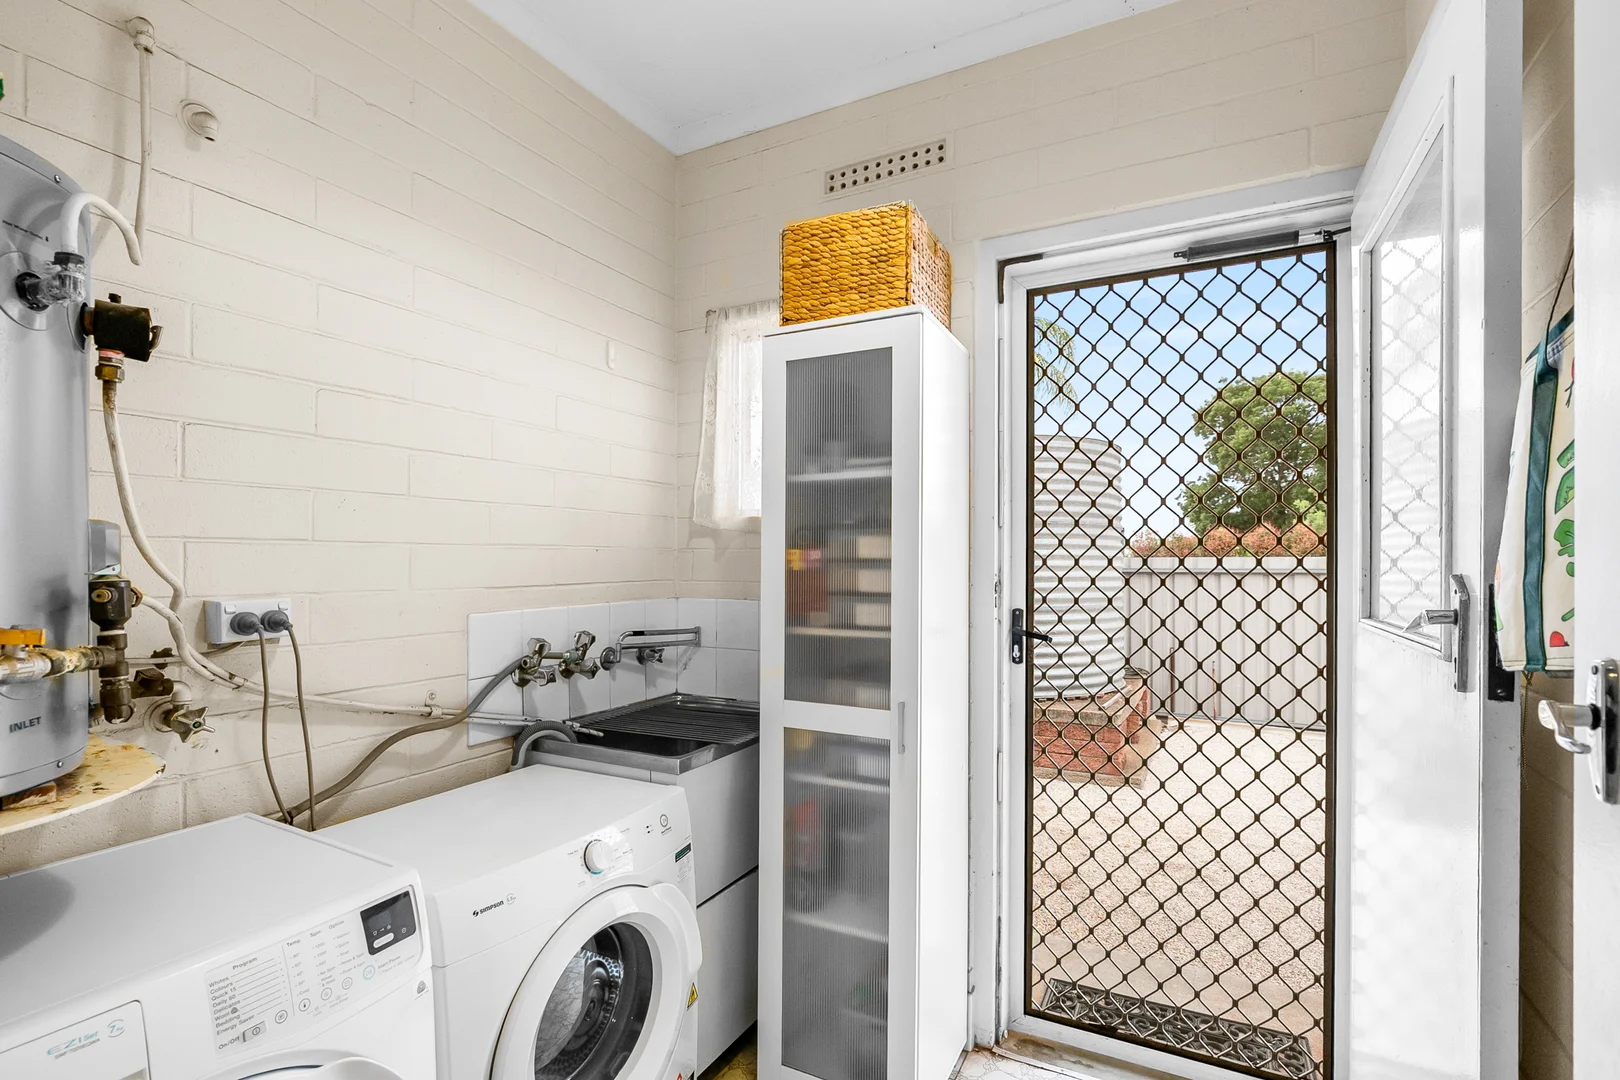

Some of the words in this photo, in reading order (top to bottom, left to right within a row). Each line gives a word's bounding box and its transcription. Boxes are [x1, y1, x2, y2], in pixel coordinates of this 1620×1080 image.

[9, 716, 41, 733] INLET
[232, 957, 257, 970] Program
[209, 977, 229, 988] Whites
[210, 982, 233, 994] Colours
[211, 991, 228, 1001] Quick
[214, 1000, 240, 1015] Delicates
